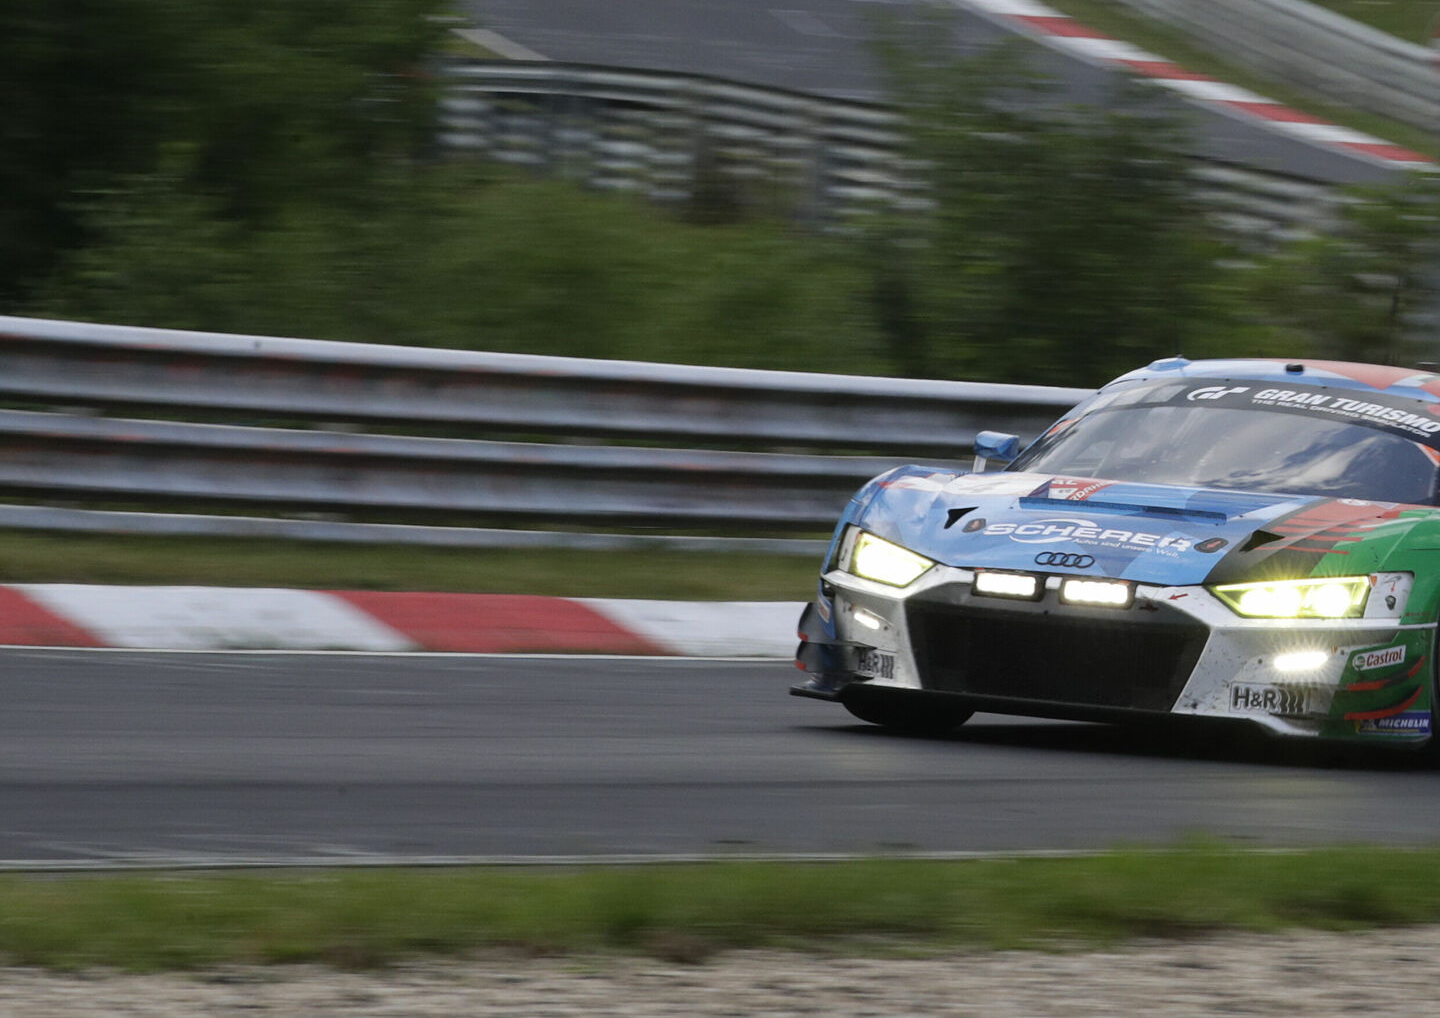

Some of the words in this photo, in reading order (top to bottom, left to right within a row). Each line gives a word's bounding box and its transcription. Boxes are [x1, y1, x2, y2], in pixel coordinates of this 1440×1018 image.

[1253, 388, 1333, 405] GRAN
[1251, 398, 1276, 406] THE
[1276, 401, 1308, 410] REAL
[1308, 404, 1360, 418] DRIVING
[1360, 413, 1432, 438] SIMULATOR
[983, 523, 1192, 552] SCHERER
[1072, 537, 1099, 546] Autos
[1101, 541, 1121, 549] sind
[1121, 544, 1153, 553] unsere
[1366, 649, 1403, 668] Castrol
[1233, 687, 1277, 709] H&R
[1379, 718, 1430, 728] MICHELIN
